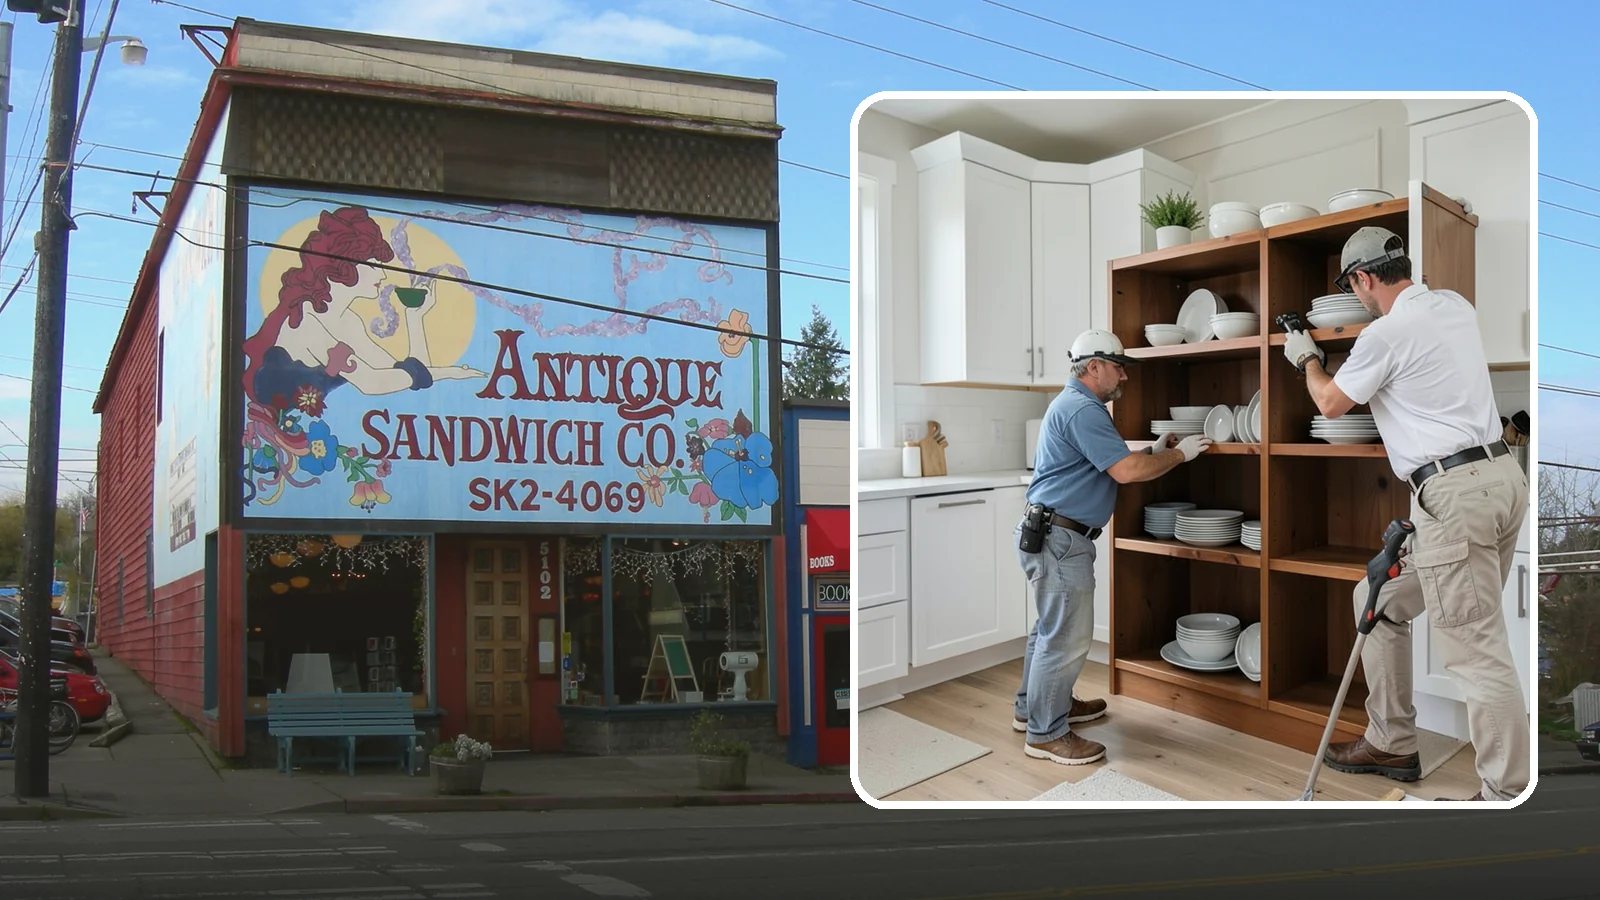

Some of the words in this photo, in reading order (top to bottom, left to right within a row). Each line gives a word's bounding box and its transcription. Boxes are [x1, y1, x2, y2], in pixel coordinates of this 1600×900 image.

[477, 329, 723, 420] ANTIQUE
[362, 408, 603, 466] SANDWICH
[617, 422, 686, 468] CO.
[469, 478, 645, 513] SK2-4069
[540, 542, 552, 599] 5102
[809, 555, 835, 569] BOOKS
